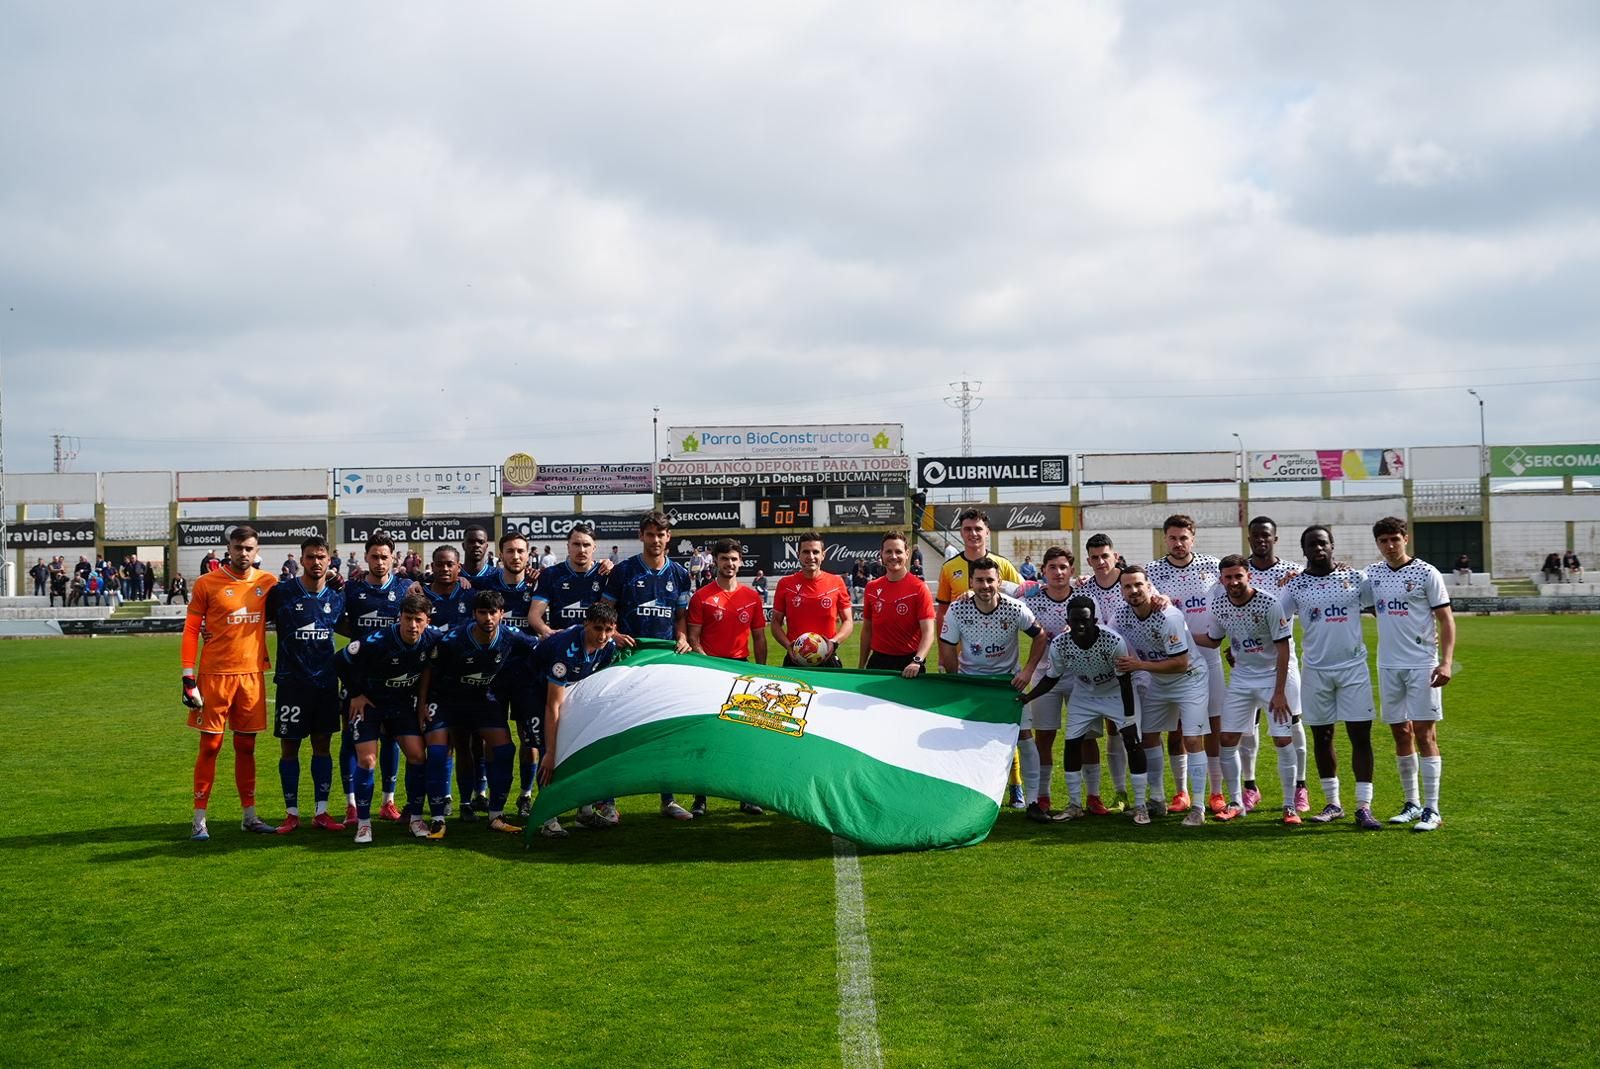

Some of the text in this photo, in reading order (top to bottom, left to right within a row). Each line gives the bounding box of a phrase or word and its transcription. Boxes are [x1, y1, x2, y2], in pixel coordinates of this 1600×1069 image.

[701, 430, 870, 445] Parra BioConstructora
[539, 465, 590, 475] Bricolaje
[600, 465, 650, 474] Maderas
[658, 458, 909, 474] POZOBLANCO DEPORTE PARA TOD@S
[948, 464, 1038, 480] LUBRIVALLE
[688, 475, 703, 486] La
[704, 474, 747, 487] bodega
[748, 476, 755, 486] y
[757, 474, 770, 484] La
[772, 473, 814, 484] Dehesa
[816, 472, 831, 482] DE
[833, 471, 880, 482] LUCMAN
[544, 484, 611, 492] Compresores
[676, 511, 740, 521] SERCOMALLA
[1006, 506, 1046, 529] Vinilo
[189, 524, 225, 532] JUNKERS
[288, 525, 318, 537] PRIEGO
[530, 516, 548, 534] el
[193, 535, 221, 544] BOSCH
[351, 528, 368, 542] La
[411, 526, 434, 541] del
[438, 528, 466, 540] Jam
[773, 559, 803, 570] NÓMA
[1185, 595, 1206, 608] chc
[1387, 597, 1409, 611] chc
[561, 609, 587, 618] LOT
[636, 607, 672, 618] LOTUS
[1324, 603, 1348, 617] chc
[227, 615, 261, 625] LOTUS
[501, 618, 529, 628] OTUS
[295, 631, 329, 640] LOTUS
[1242, 636, 1263, 648] chc
[280, 705, 300, 723] 22
